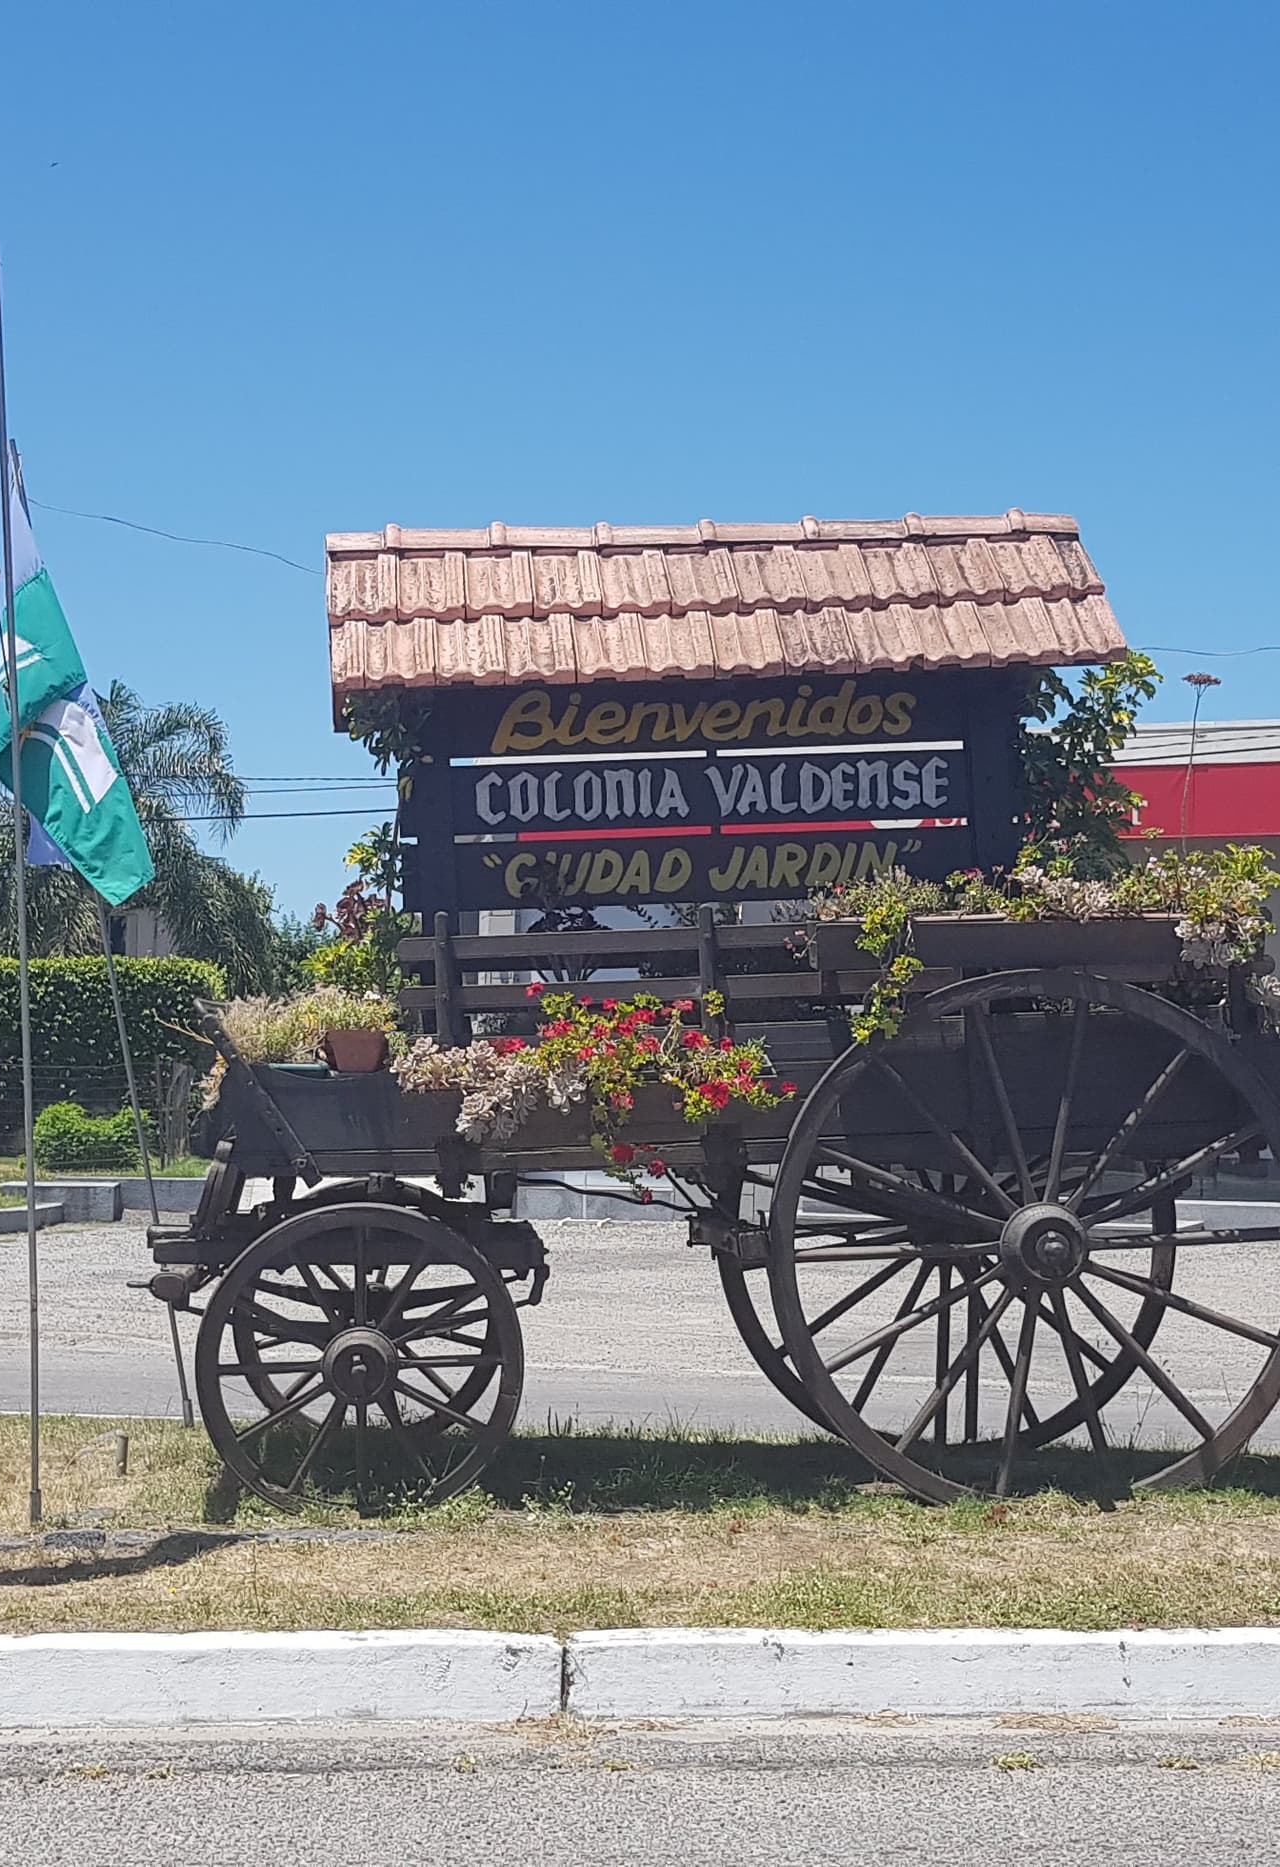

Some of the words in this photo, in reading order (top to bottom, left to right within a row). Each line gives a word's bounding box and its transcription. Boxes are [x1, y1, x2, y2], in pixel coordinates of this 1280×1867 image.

[490, 679, 918, 754] Bienvenidos
[475, 766, 690, 826] COLONIA
[703, 756, 949, 817] VALDENSE
